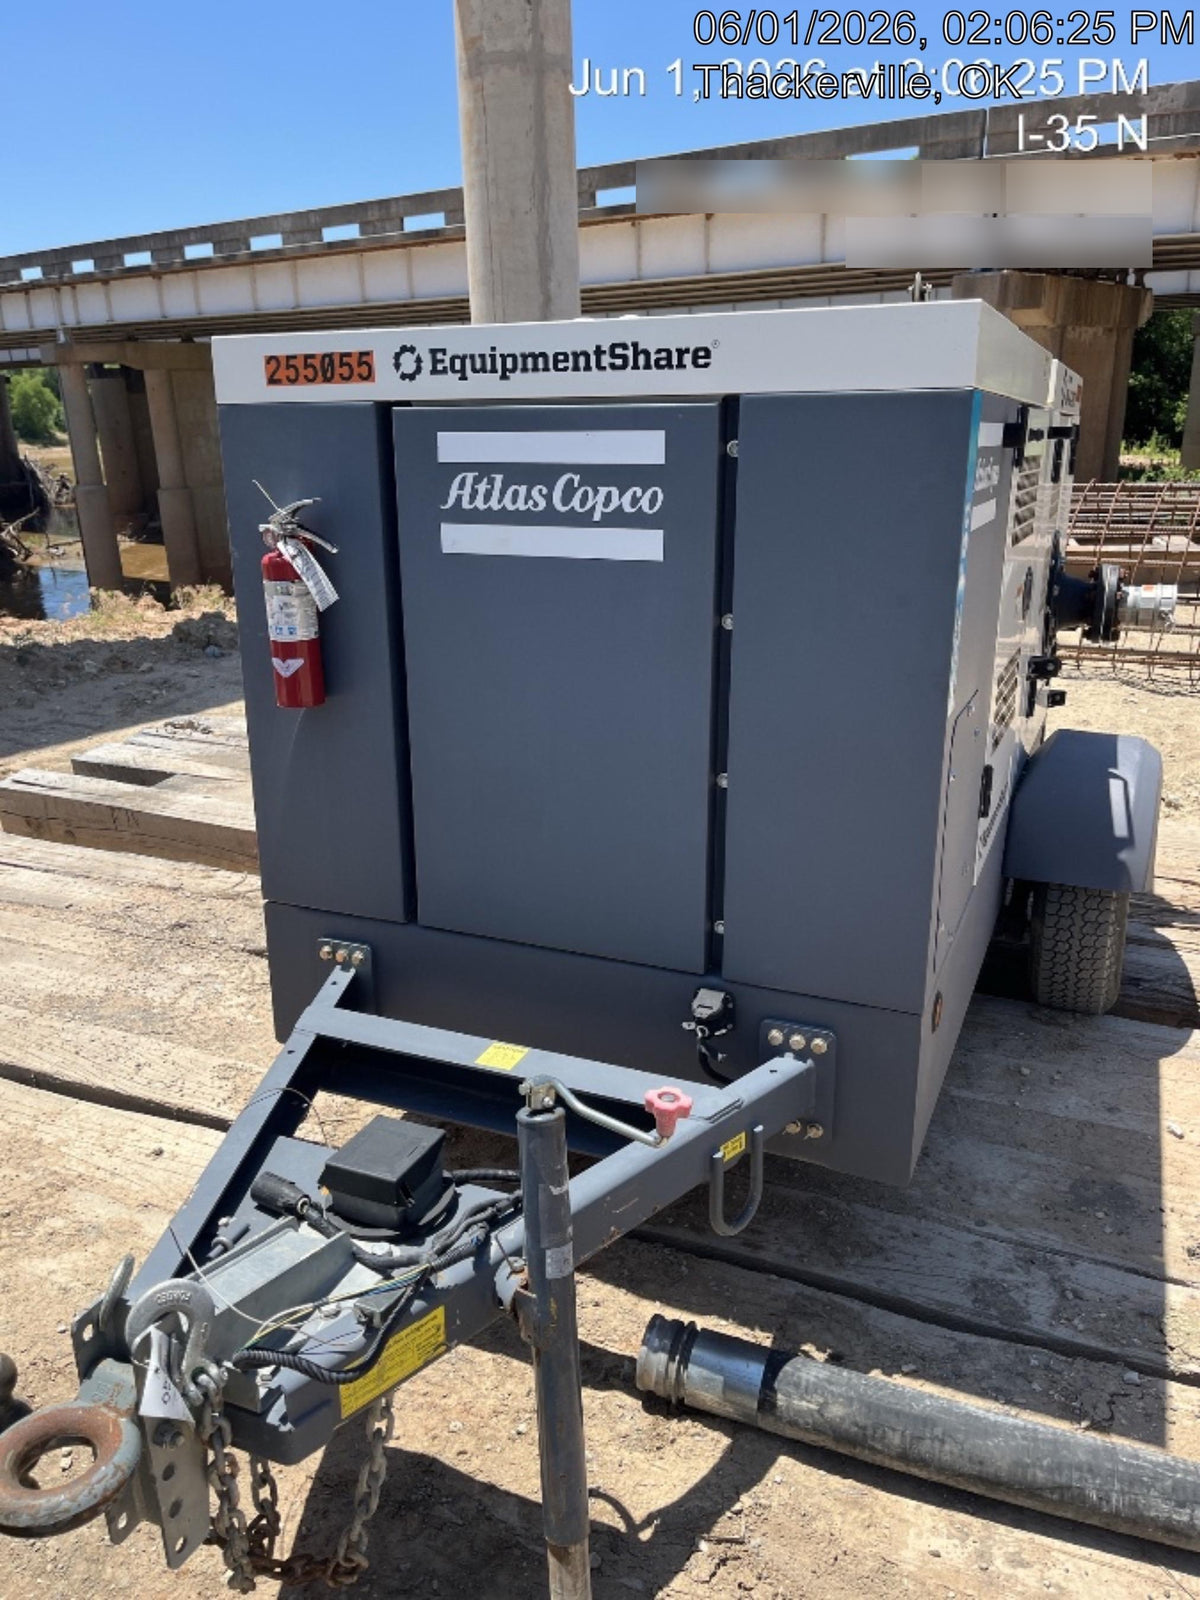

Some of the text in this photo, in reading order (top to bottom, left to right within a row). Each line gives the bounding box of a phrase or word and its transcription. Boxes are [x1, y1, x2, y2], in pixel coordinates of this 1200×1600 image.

[265, 349, 374, 385] 255055
[428, 341, 713, 381] EquipmentShare
[439, 471, 665, 522] Atlas Copco
